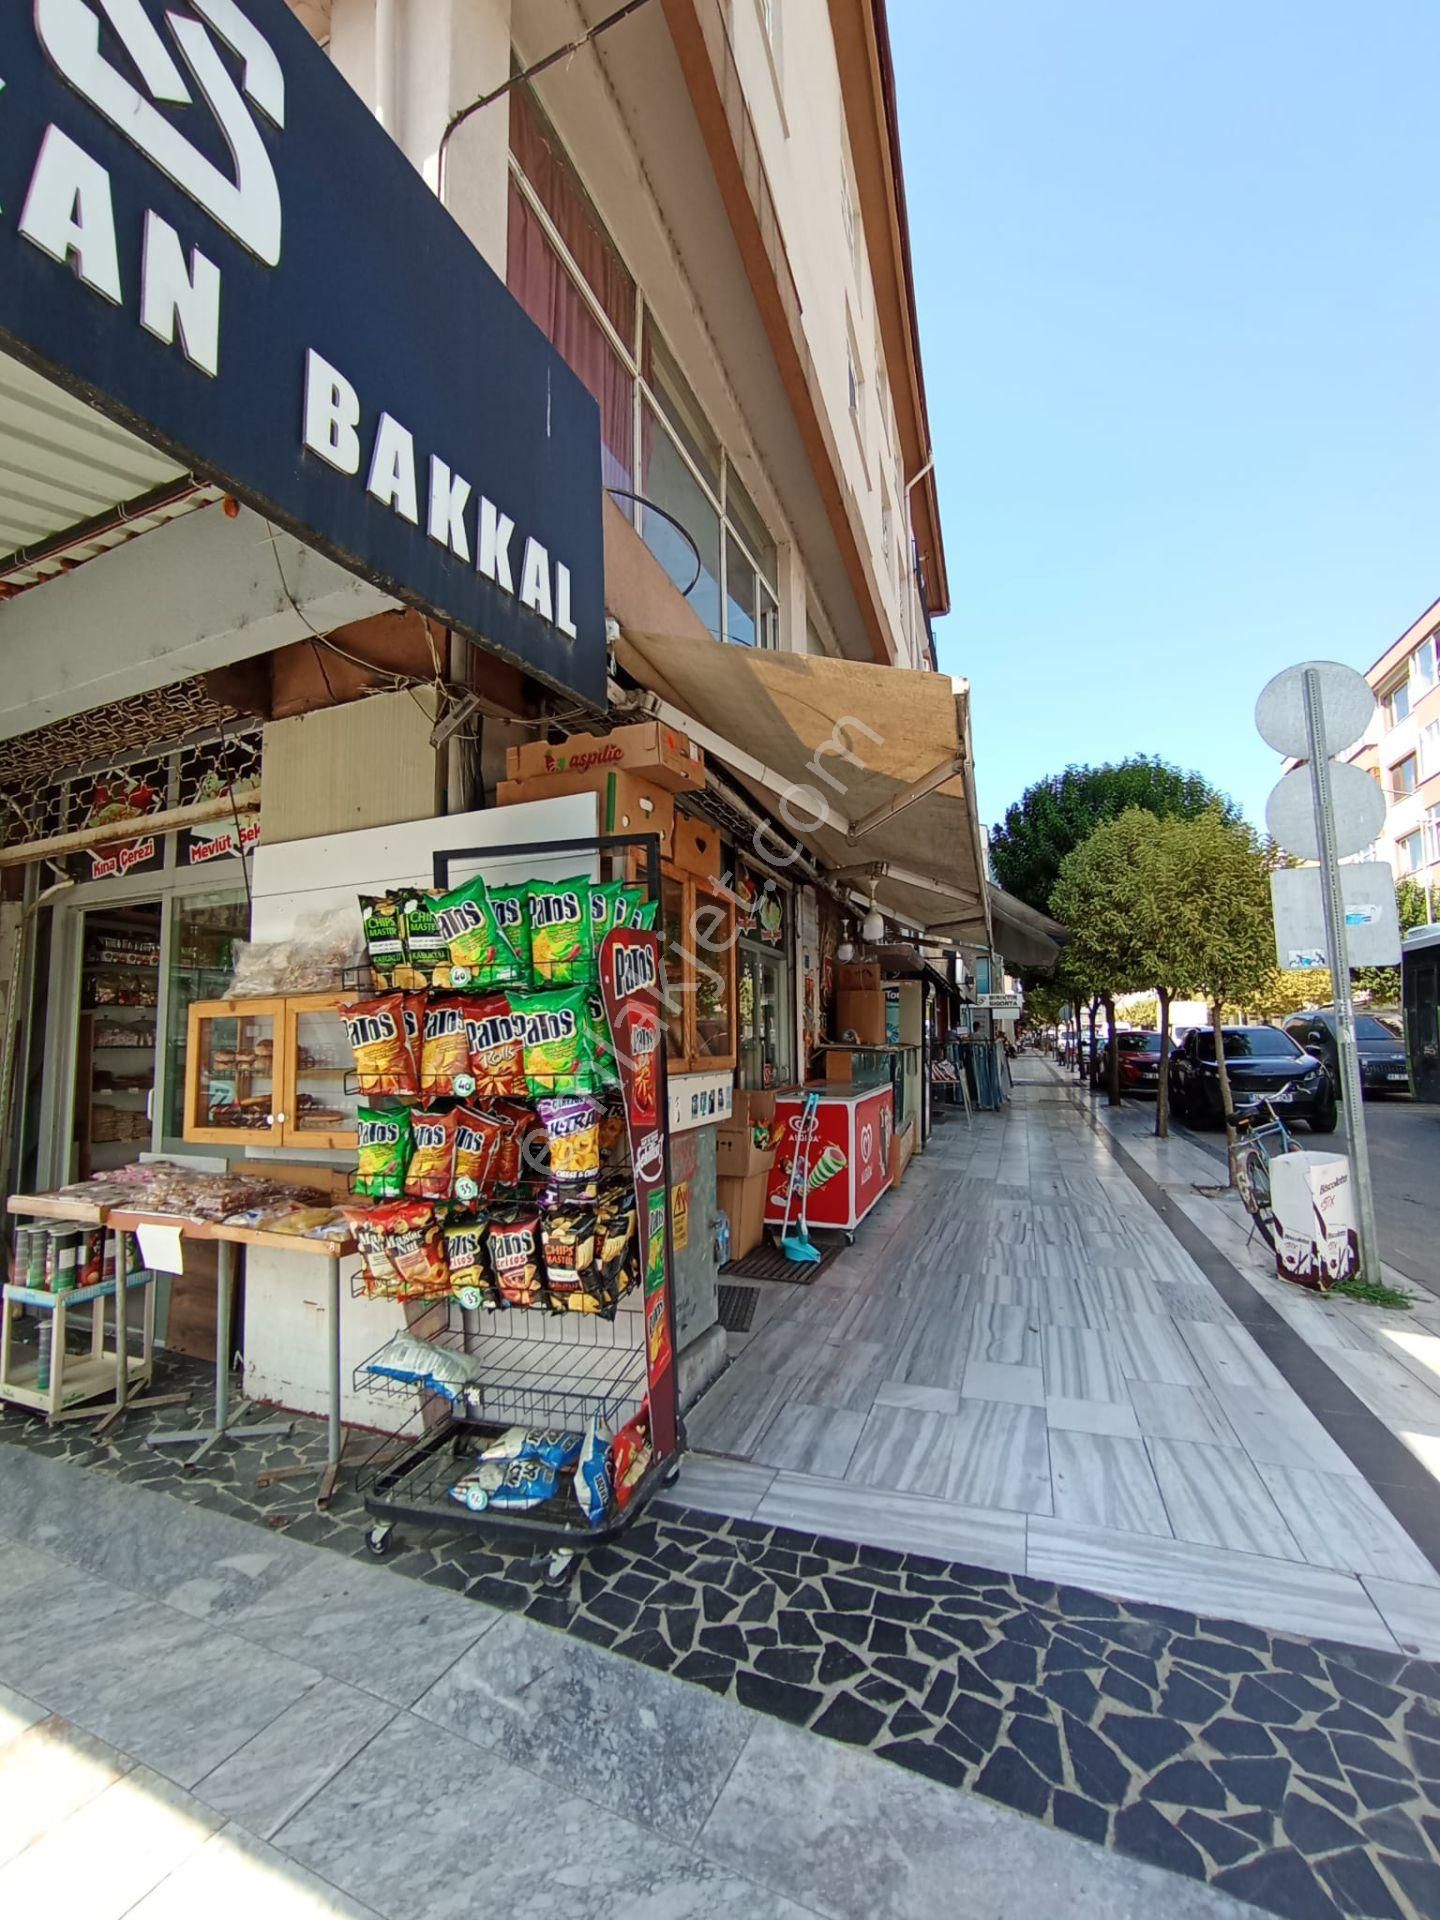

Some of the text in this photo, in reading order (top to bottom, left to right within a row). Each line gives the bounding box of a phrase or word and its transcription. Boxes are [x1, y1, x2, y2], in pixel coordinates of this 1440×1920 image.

[0, 110, 577, 640] AN BAKKAL
[92, 840, 154, 878] Kına Çerezi
[191, 834, 233, 861] Mevlüt
[410, 910, 434, 923] CHI
[410, 922, 440, 932] MASTE
